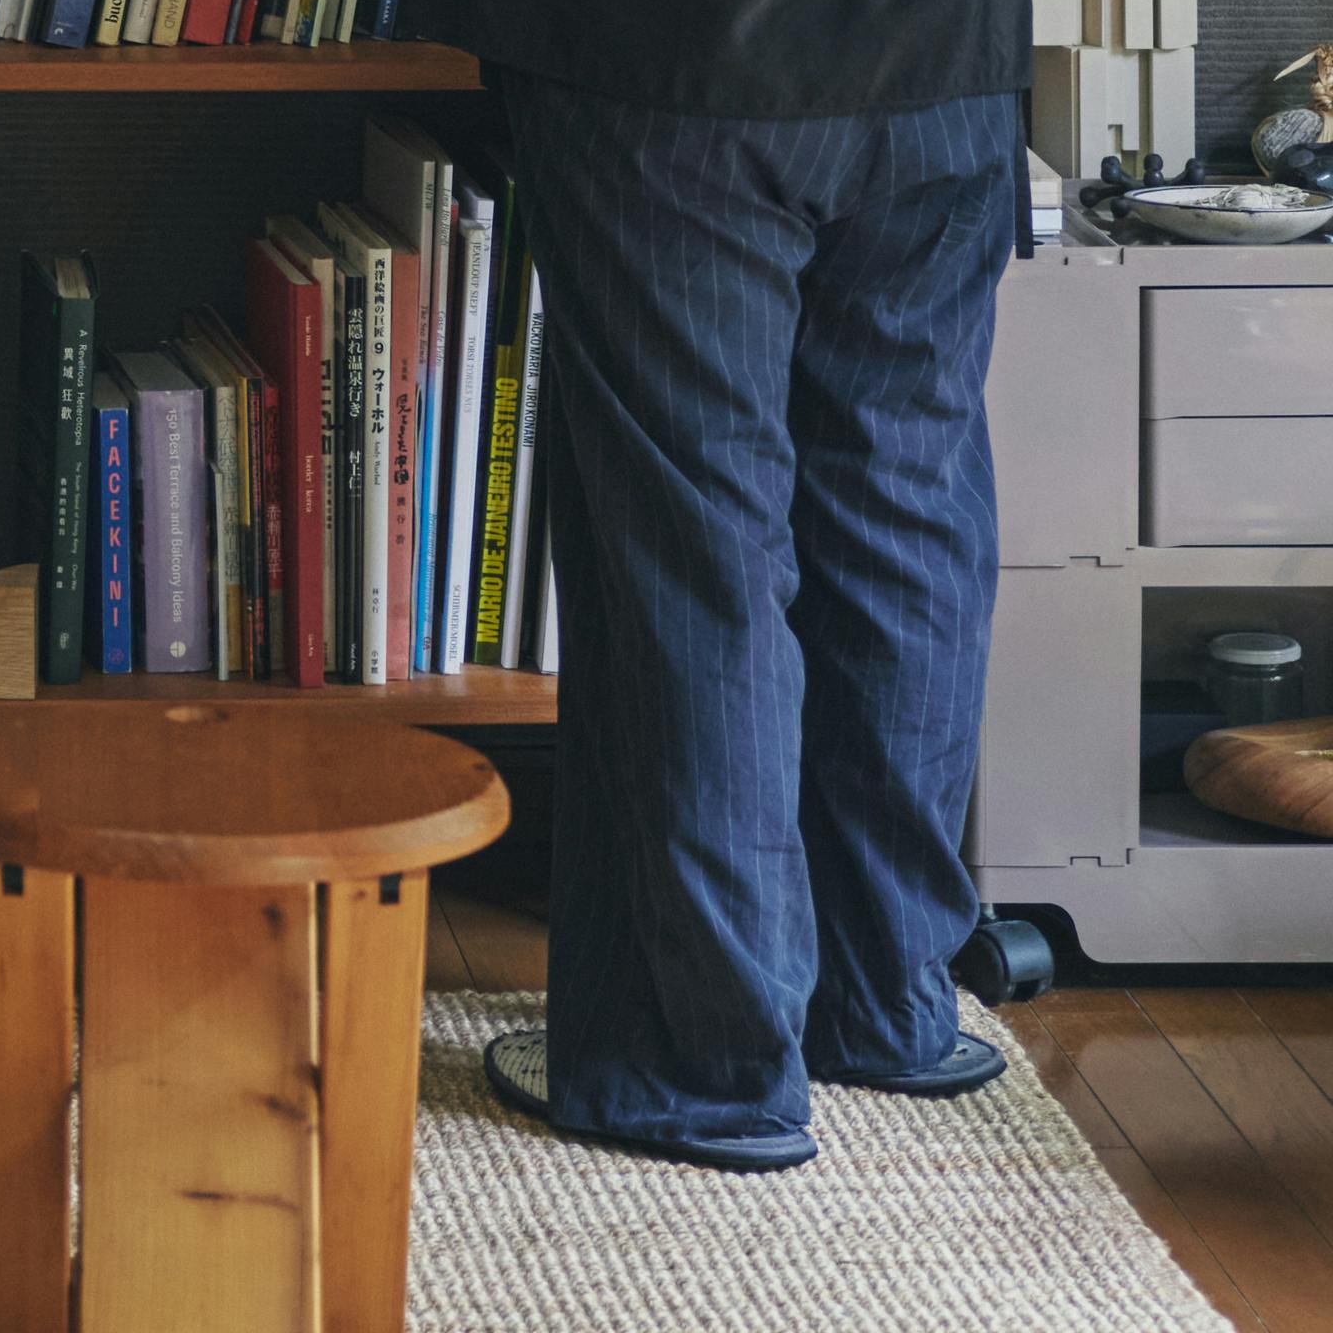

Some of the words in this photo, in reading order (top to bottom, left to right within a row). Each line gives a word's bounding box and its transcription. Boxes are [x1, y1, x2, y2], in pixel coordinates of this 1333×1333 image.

[167, 409, 179, 429] 150
[169, 433, 181, 461] Best
[169, 463, 183, 511] Terrace
[107, 419, 123, 627] FACEKINI
[170, 513, 183, 535] and
[168, 539, 185, 587] Balcony
[172, 590, 185, 622] Ideas
